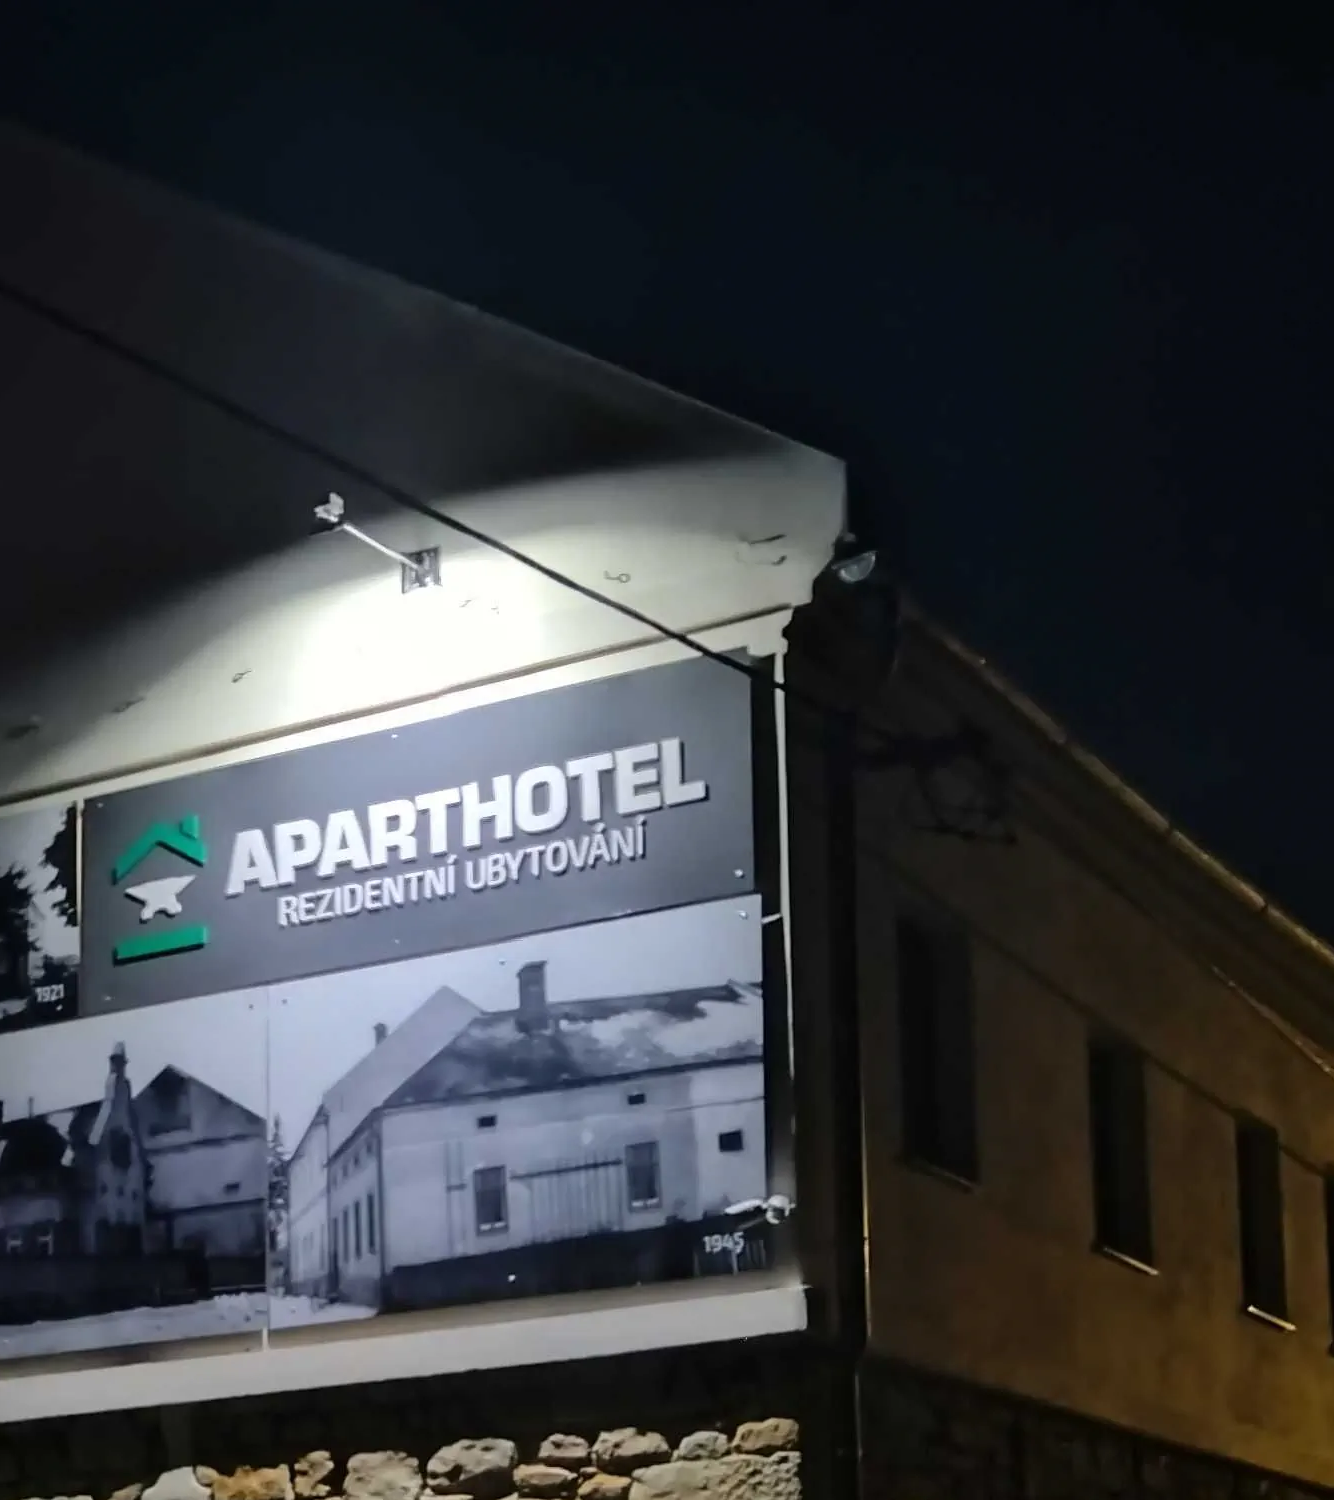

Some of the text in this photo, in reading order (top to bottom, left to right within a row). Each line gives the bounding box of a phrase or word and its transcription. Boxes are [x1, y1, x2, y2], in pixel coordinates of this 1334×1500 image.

[225, 738, 708, 897] APARTHOTEL
[279, 817, 648, 926] REZIDENTNÍ UBYTOVÁNÍ
[35, 984, 64, 1002] 1921
[703, 1232, 744, 1254] 1945
